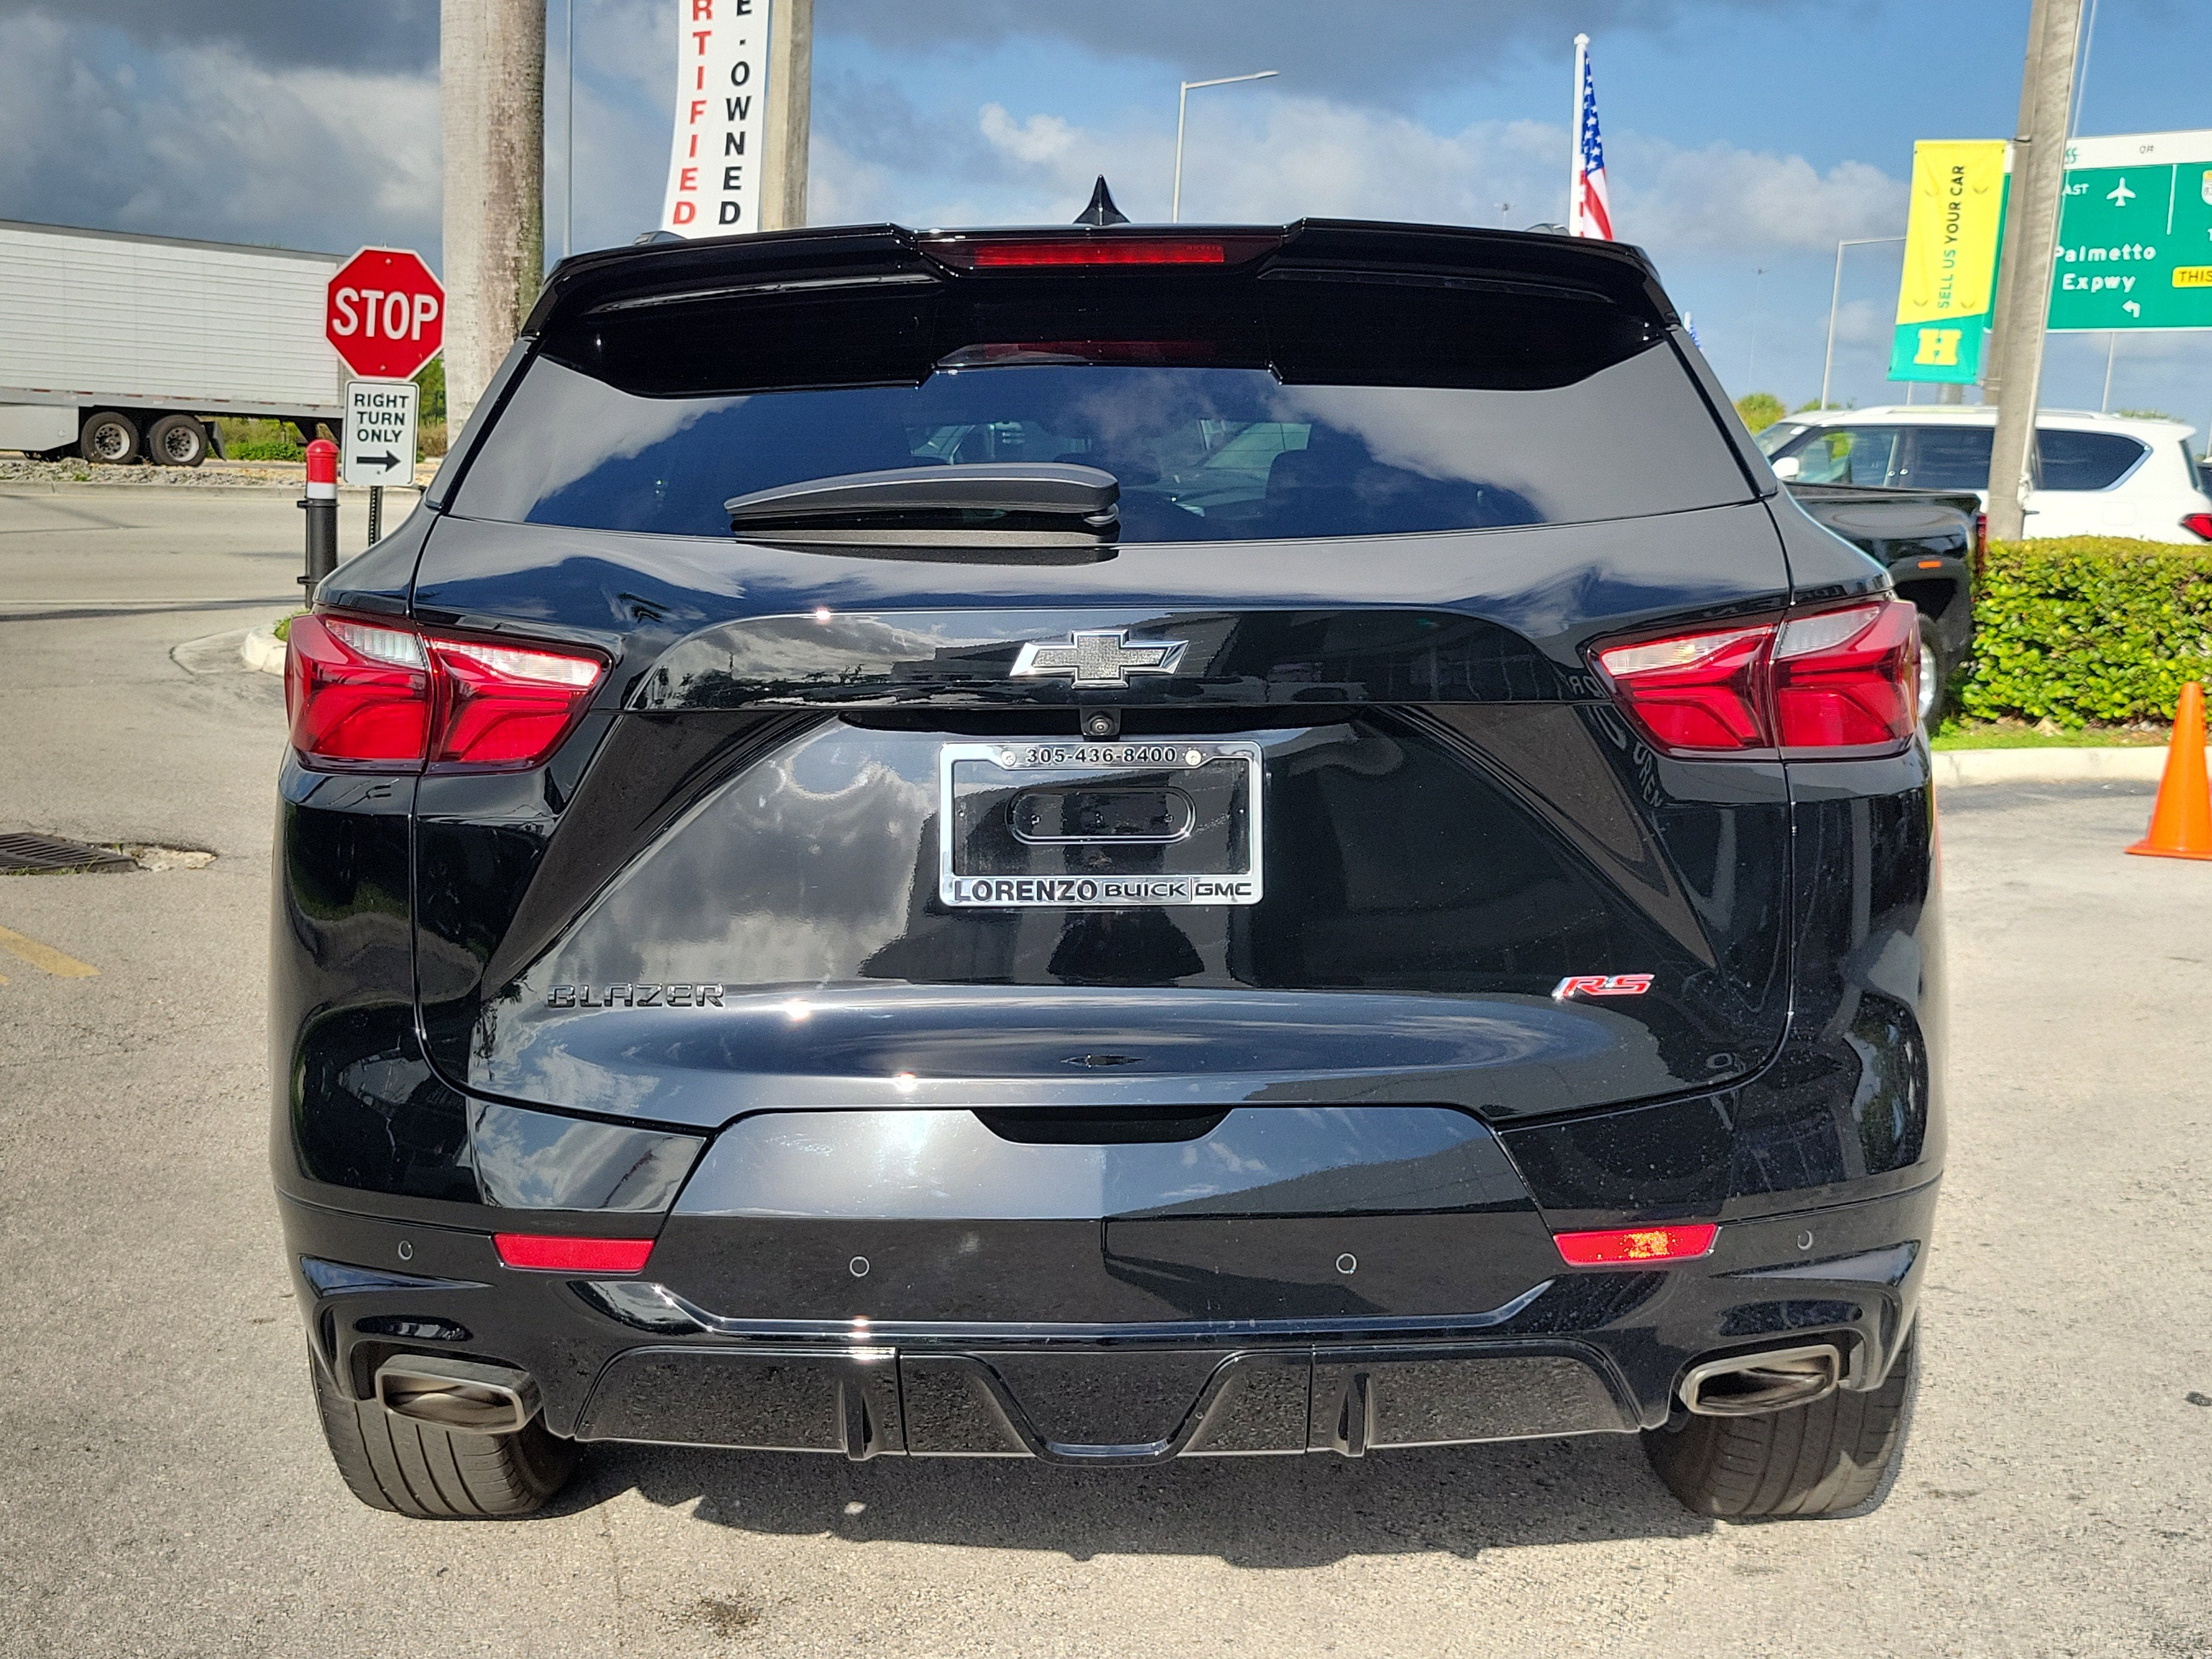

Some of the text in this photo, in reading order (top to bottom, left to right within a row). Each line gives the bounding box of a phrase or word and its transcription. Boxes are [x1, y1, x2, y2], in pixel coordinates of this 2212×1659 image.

[1937, 165, 1964, 308] SELL US YOUR CAR
[2055, 243, 2157, 263] Palmetto
[2062, 273, 2136, 293] Expwy
[332, 286, 439, 341] STOP
[354, 393, 409, 408] RIGHT
[357, 411, 405, 425] TURN
[357, 429, 403, 443] ONLY
[1025, 747, 1177, 764] 305-436-8400
[954, 879, 1252, 902] LORENZO BUICK GMC
[547, 983, 725, 1008] BLAZER
[1551, 974, 1656, 1000] RS
